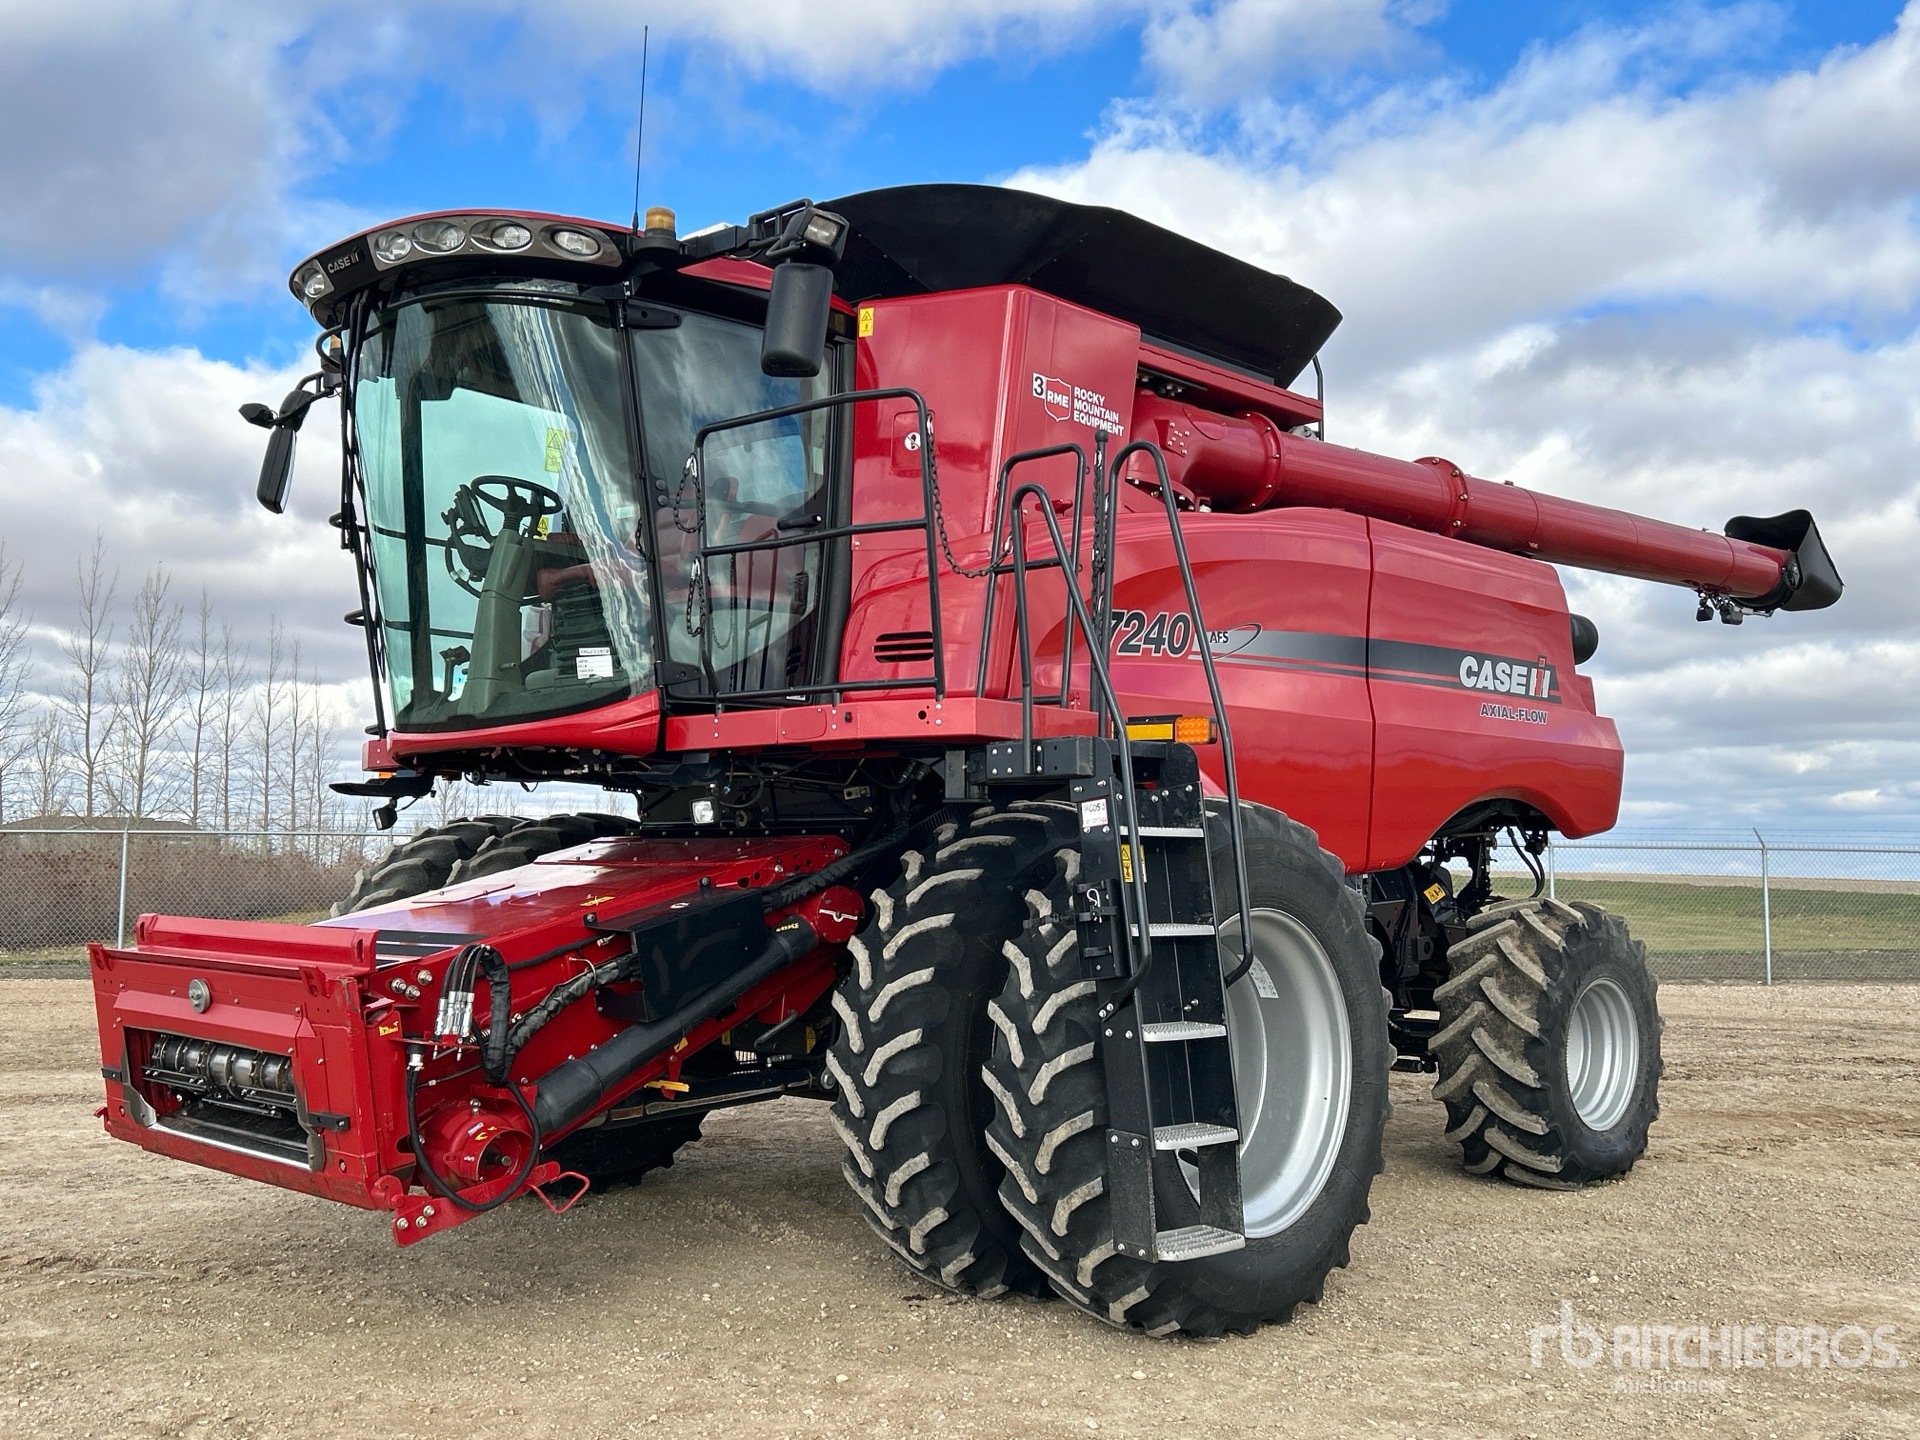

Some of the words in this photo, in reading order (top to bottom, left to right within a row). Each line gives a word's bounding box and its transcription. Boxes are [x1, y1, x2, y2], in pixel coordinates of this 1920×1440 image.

[327, 256, 350, 273] CASE
[1034, 376, 1044, 396] 3
[1047, 390, 1069, 408] RME
[1074, 387, 1105, 406] ROCKY
[1074, 399, 1119, 423] MOUNTAIN
[1074, 411, 1124, 436] EQUIPMENT
[1110, 609, 1192, 658] 7240
[1209, 631, 1229, 644] AFS
[1459, 656, 1528, 695] CASE
[1480, 703, 1548, 724] AXIAL-FLOW
